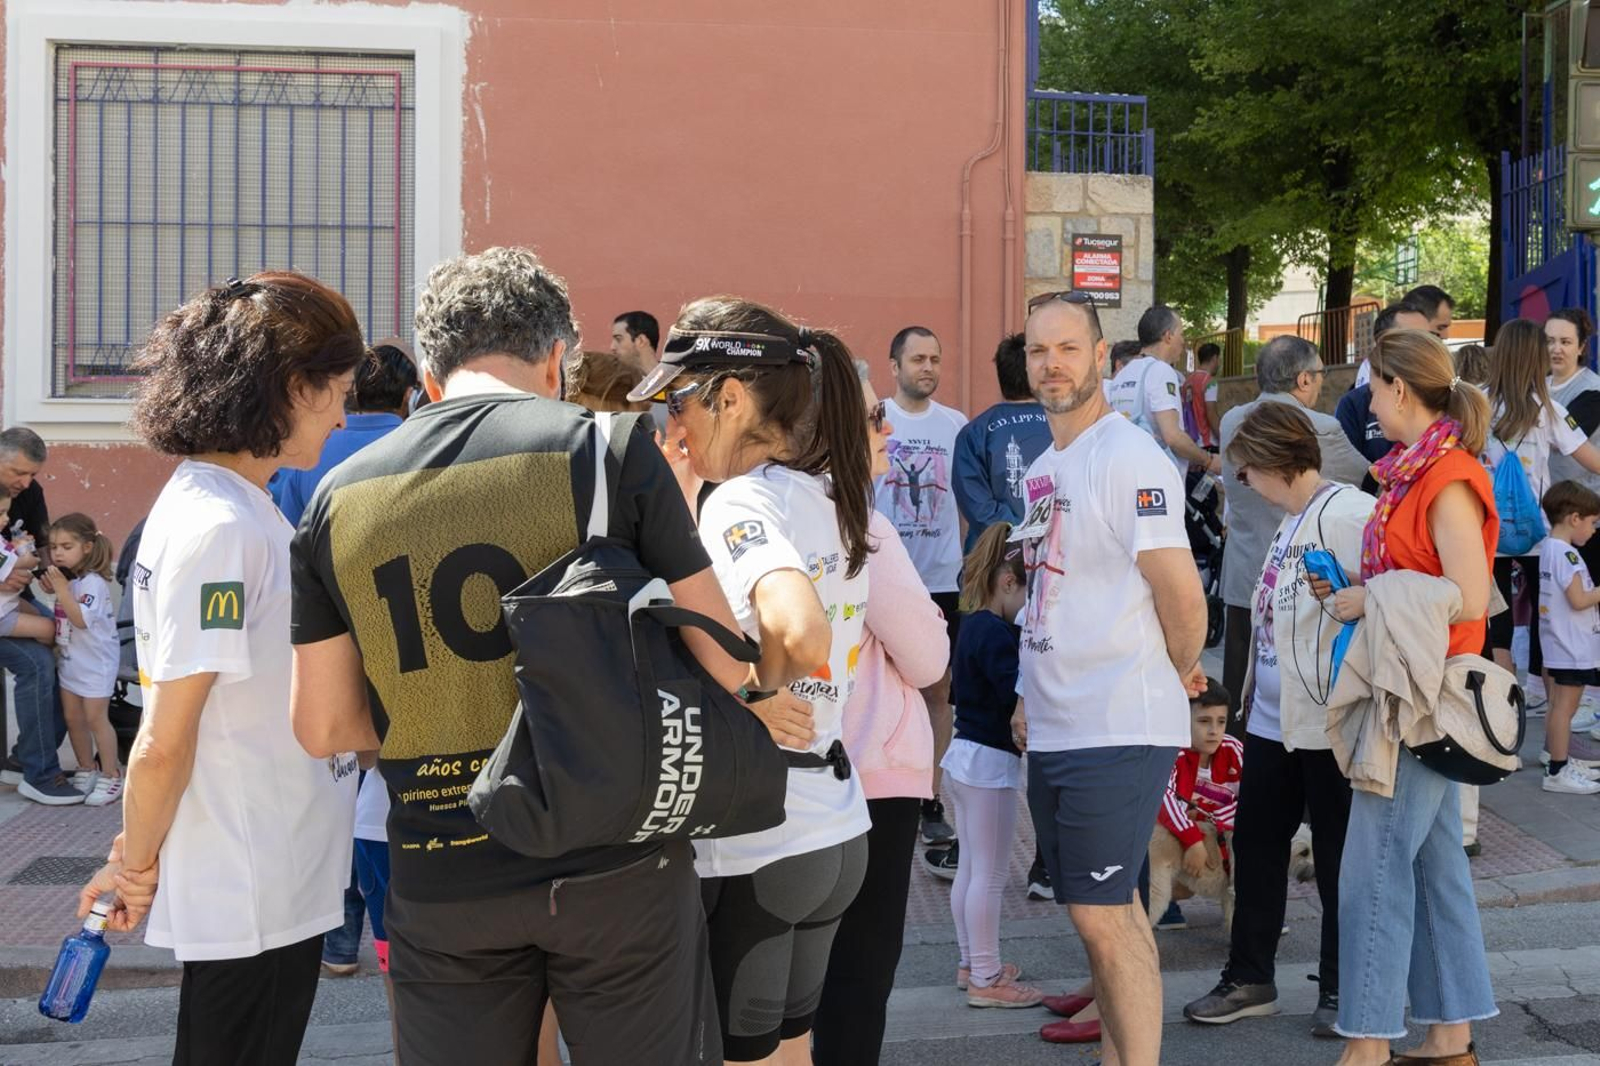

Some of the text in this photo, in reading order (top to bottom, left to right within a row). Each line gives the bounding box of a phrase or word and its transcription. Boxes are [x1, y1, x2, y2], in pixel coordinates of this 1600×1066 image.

[1083, 237, 1119, 247] Tucsegur
[1075, 258, 1118, 266] CONECTADA
[711, 340, 741, 349] WORLD
[726, 347, 762, 357] CHAMPION
[372, 543, 529, 674] 10
[416, 757, 462, 777] años
[657, 706, 704, 834] UNDER
[402, 788, 439, 805] pirineo
[429, 802, 457, 812] Huesca
